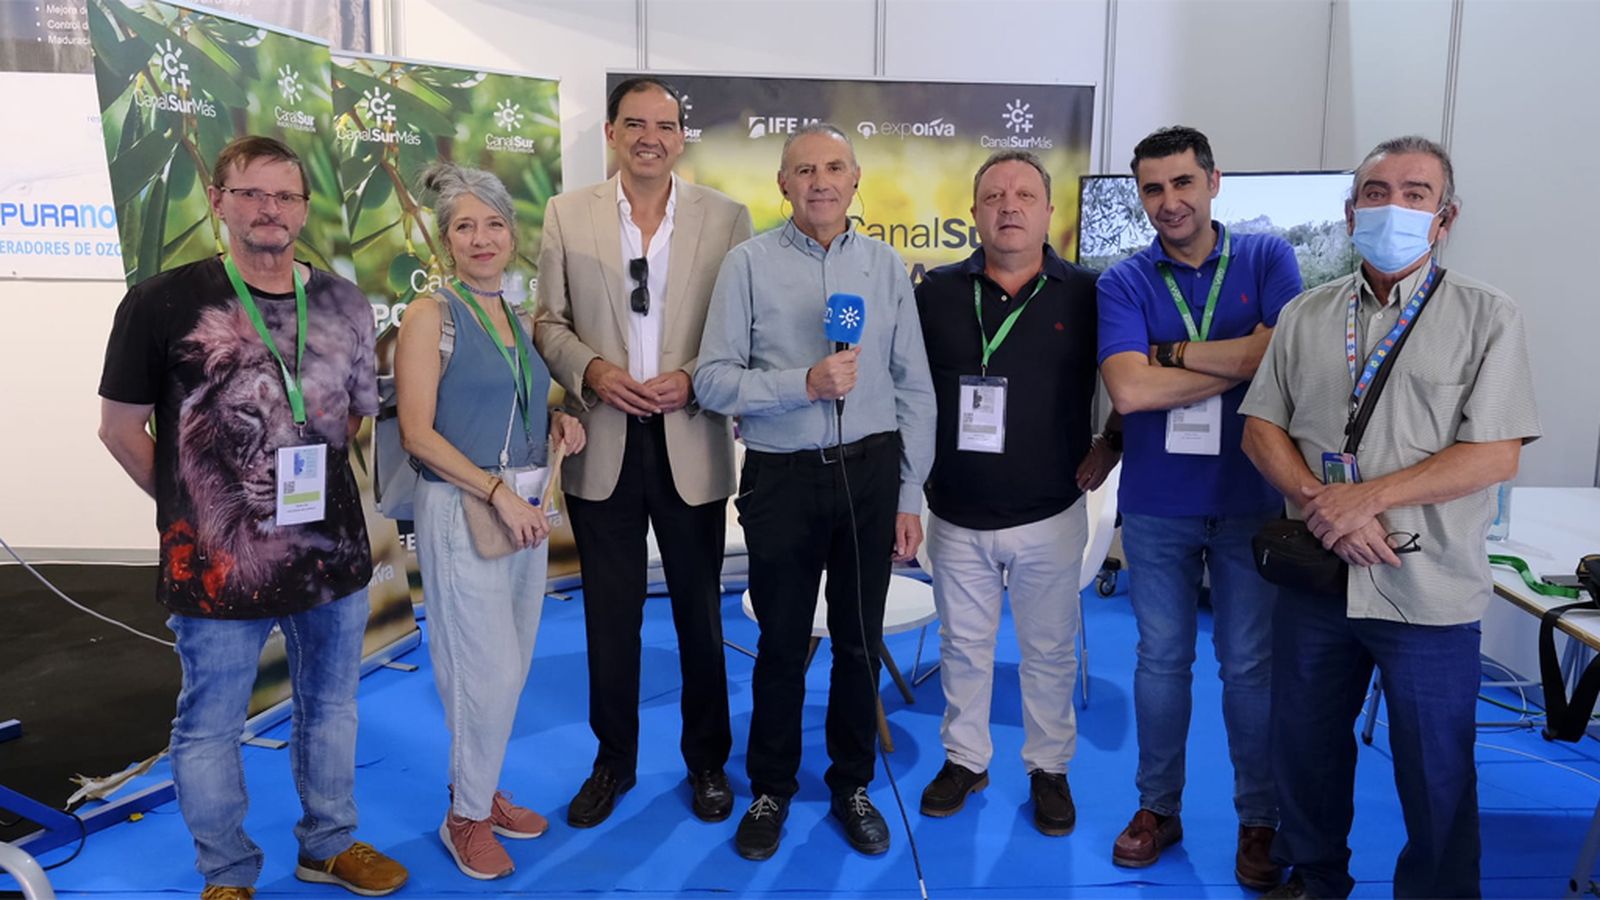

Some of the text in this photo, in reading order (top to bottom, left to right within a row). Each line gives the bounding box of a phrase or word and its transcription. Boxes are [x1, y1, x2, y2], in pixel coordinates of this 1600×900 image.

[336, 127, 421, 146] CanalSurMás
[485, 133, 534, 149] CanalSur
[980, 135, 1052, 149] CanalSurMás
[75, 241, 91, 256] DE
